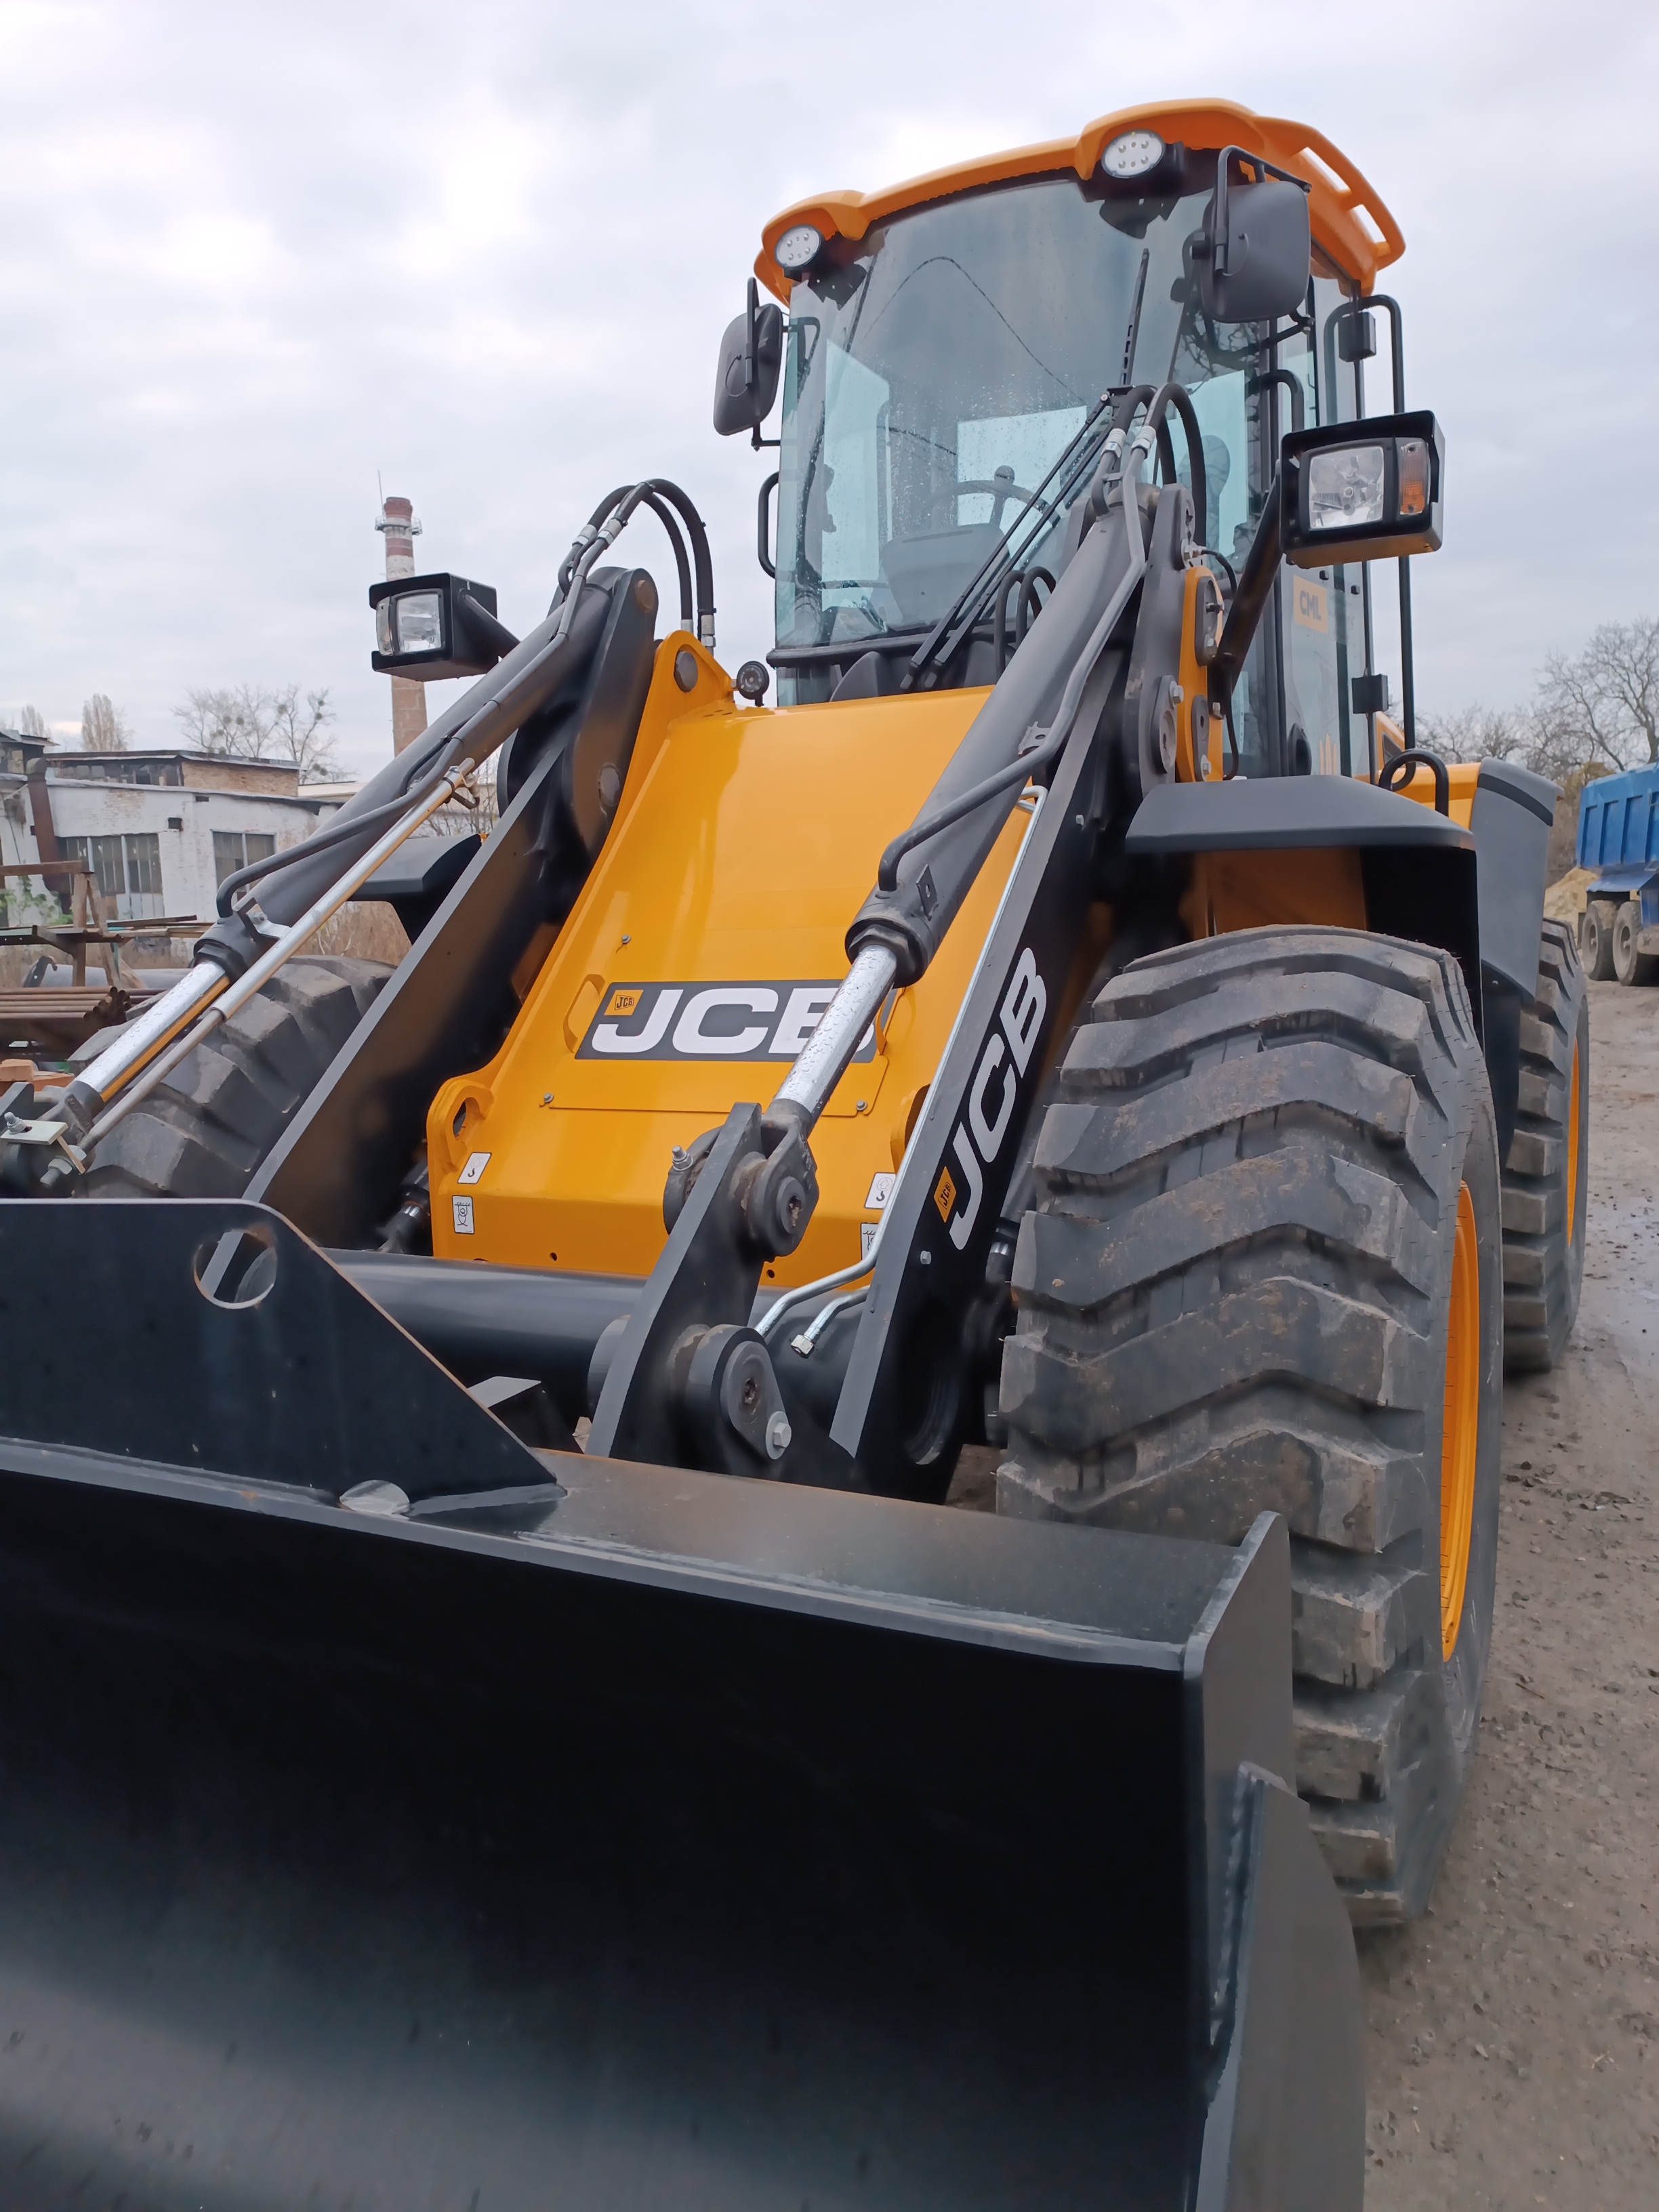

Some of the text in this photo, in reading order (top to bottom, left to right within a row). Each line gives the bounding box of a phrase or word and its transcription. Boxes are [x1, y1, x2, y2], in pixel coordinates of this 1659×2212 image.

[1300, 590, 1322, 621] CML
[616, 996, 633, 1009] JCB
[592, 987, 874, 1054] JCB
[949, 947, 1046, 1250] JCB
[940, 1183, 951, 1207] JCB
